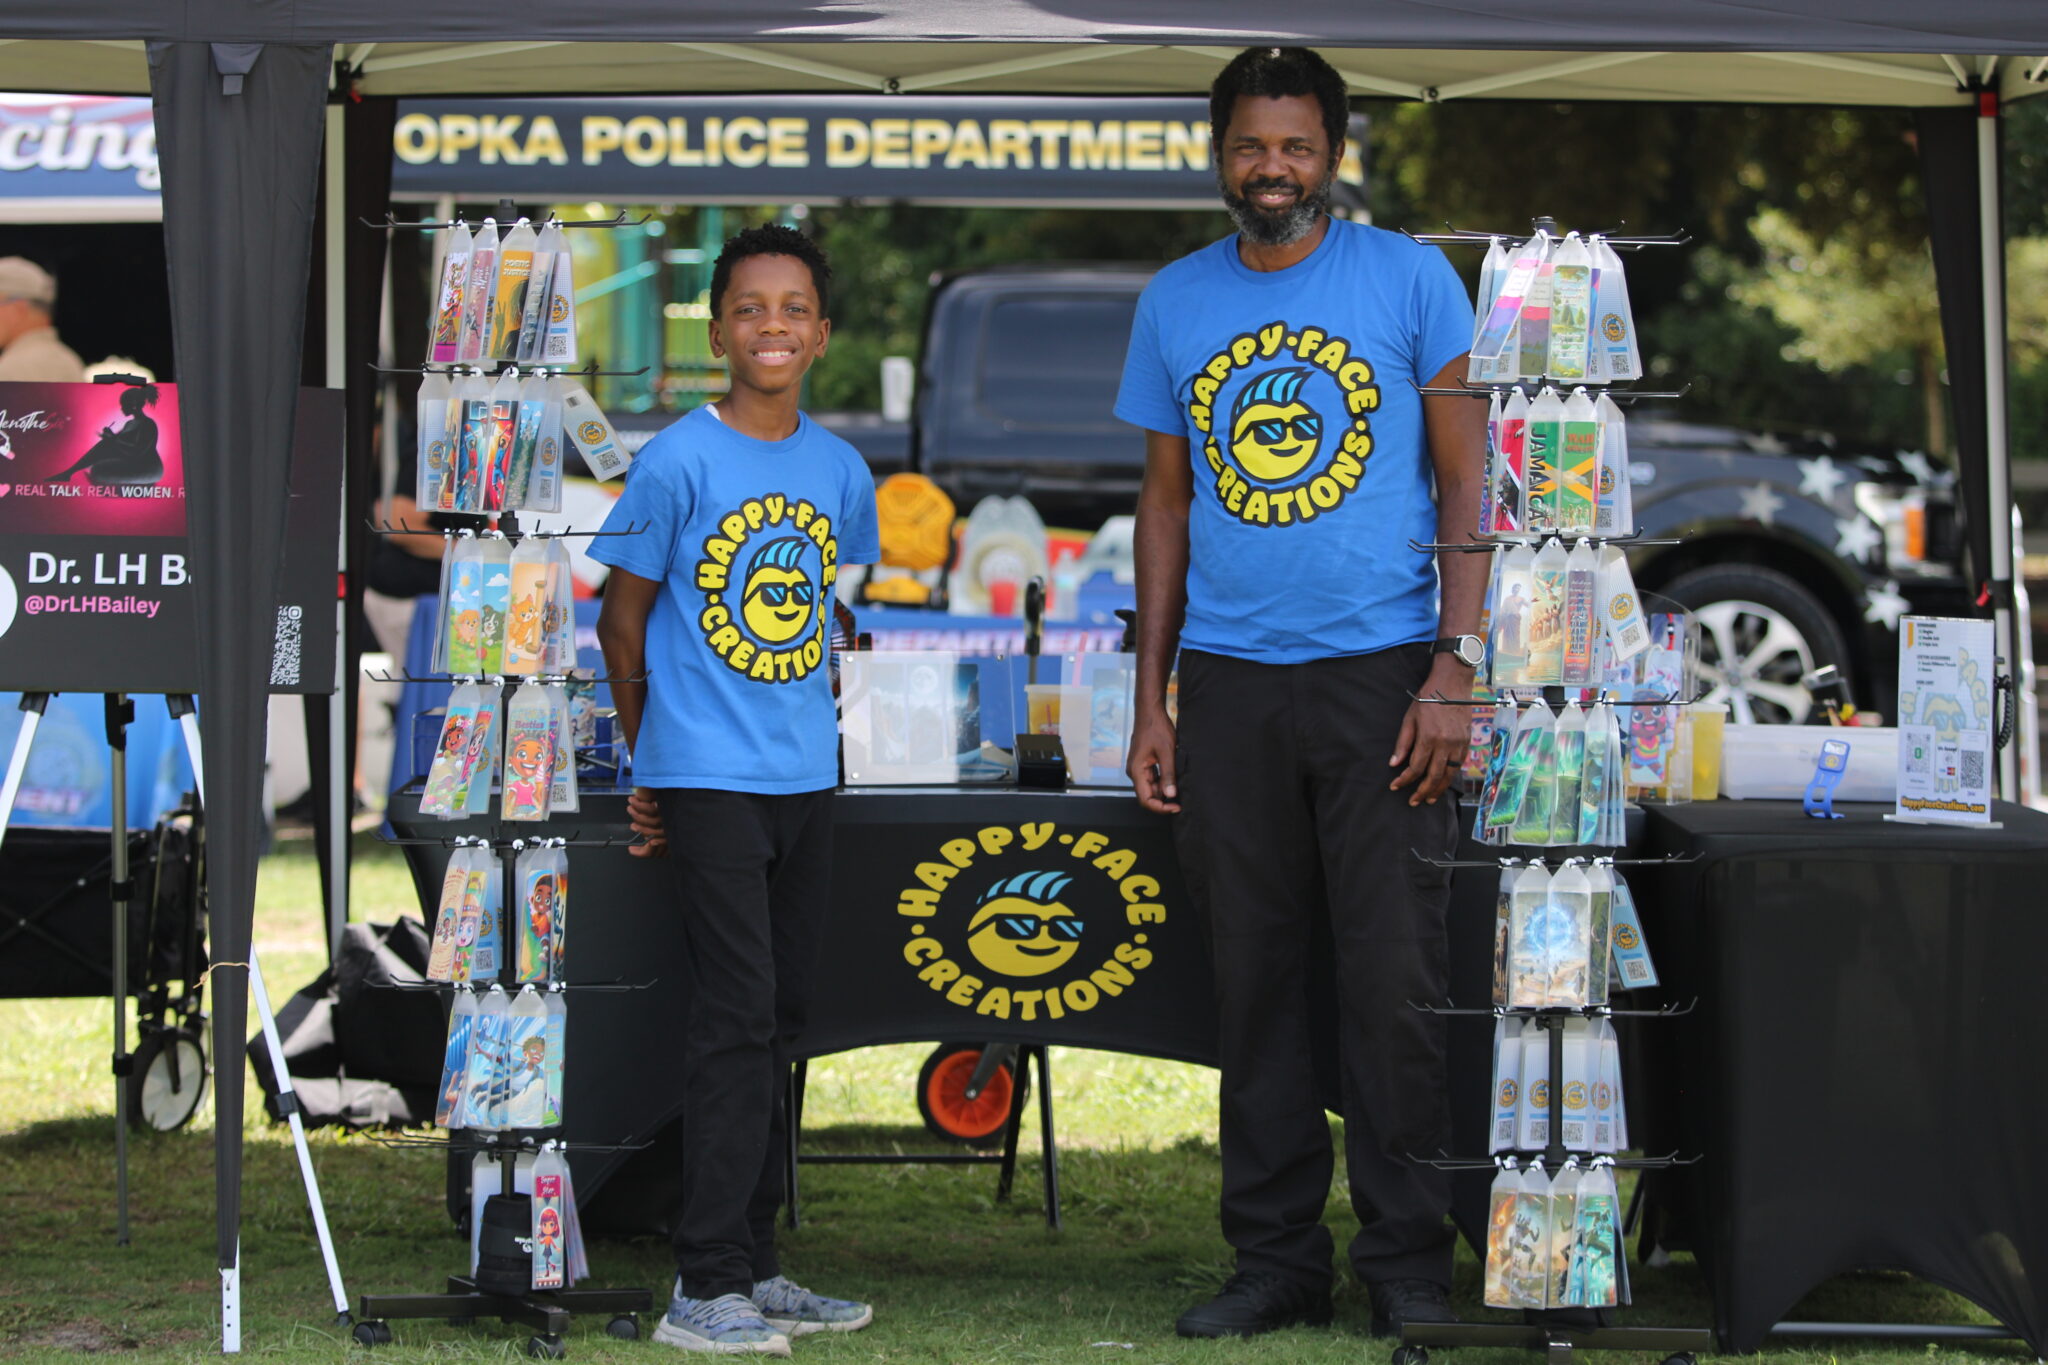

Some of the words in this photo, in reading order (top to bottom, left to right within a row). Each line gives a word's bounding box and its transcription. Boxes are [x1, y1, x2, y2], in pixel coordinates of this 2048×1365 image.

[393, 113, 568, 165] OPKA
[581, 116, 809, 168] POLICE
[825, 118, 1213, 171] DEPARTMEN
[1189, 323, 1285, 434] HAPPY
[1296, 328, 1380, 415] FACE
[15, 484, 46, 497] REAL
[88, 486, 118, 497] REAL
[1204, 430, 1372, 524] CREATIONS
[28, 552, 81, 584] Dr.
[94, 553, 148, 585] LH
[161, 554, 192, 586] B
[697, 494, 785, 591] HAPPY
[794, 500, 838, 588] FACE
[24, 595, 161, 618] @DrLHBailey
[898, 822, 1055, 917] HAPPY
[1070, 831, 1167, 926] FACE
[903, 937, 1153, 1021] CREATIONS
